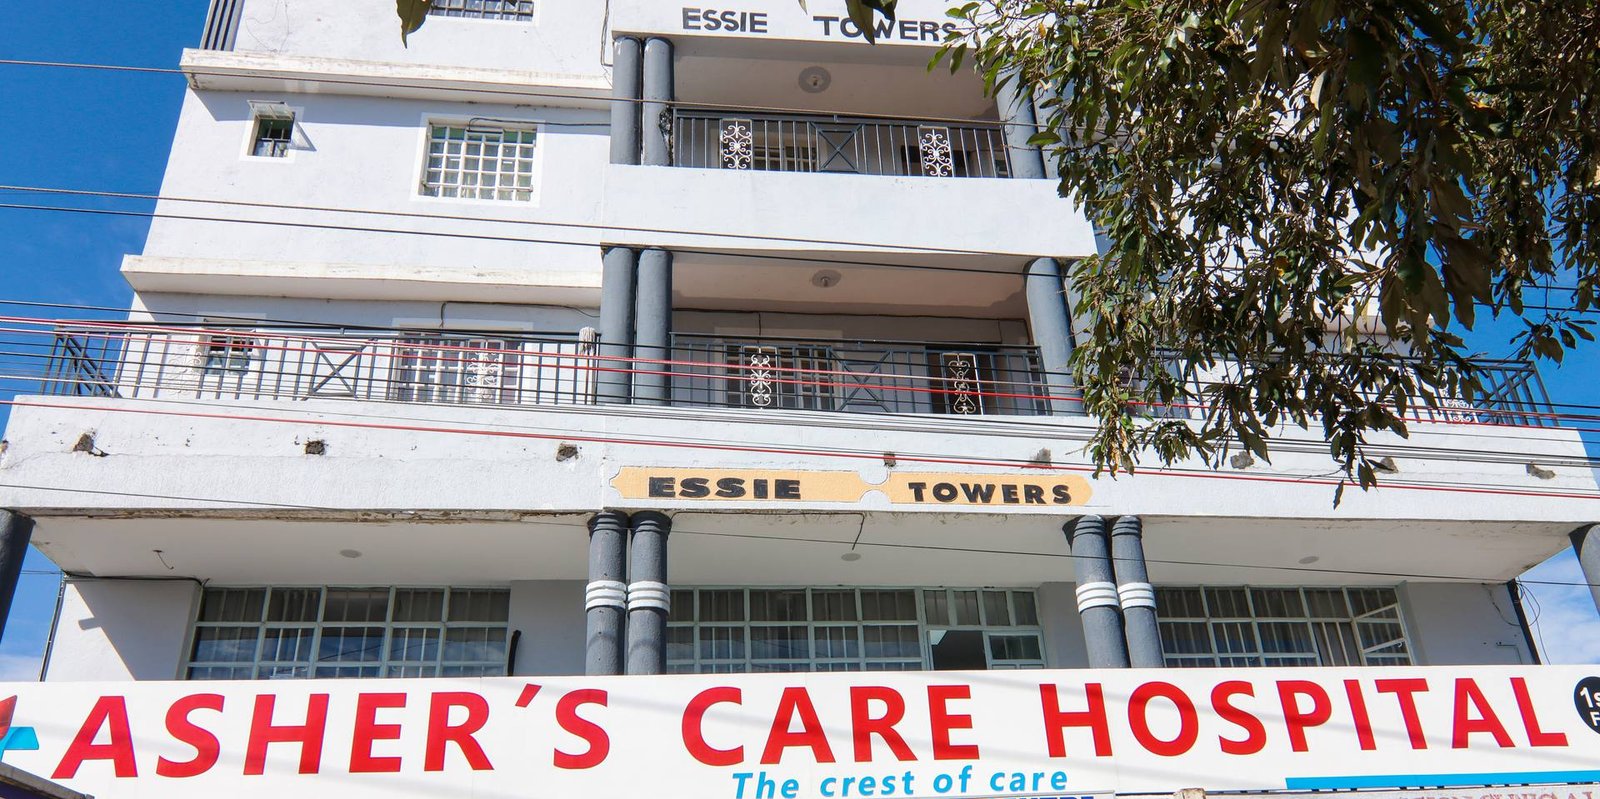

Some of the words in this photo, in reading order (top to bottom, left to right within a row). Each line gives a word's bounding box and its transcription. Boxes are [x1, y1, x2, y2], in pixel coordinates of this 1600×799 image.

[682, 7, 768, 33] ESSIE
[648, 476, 802, 500] ESSIE
[908, 481, 1072, 505] TOWERS
[51, 683, 611, 780] ASHER'S
[681, 684, 981, 768] CARE
[1039, 676, 1569, 758] HOSPITAL
[732, 770, 800, 799] The
[818, 770, 915, 799] crest
[932, 763, 973, 794] of
[988, 769, 1069, 793] care
